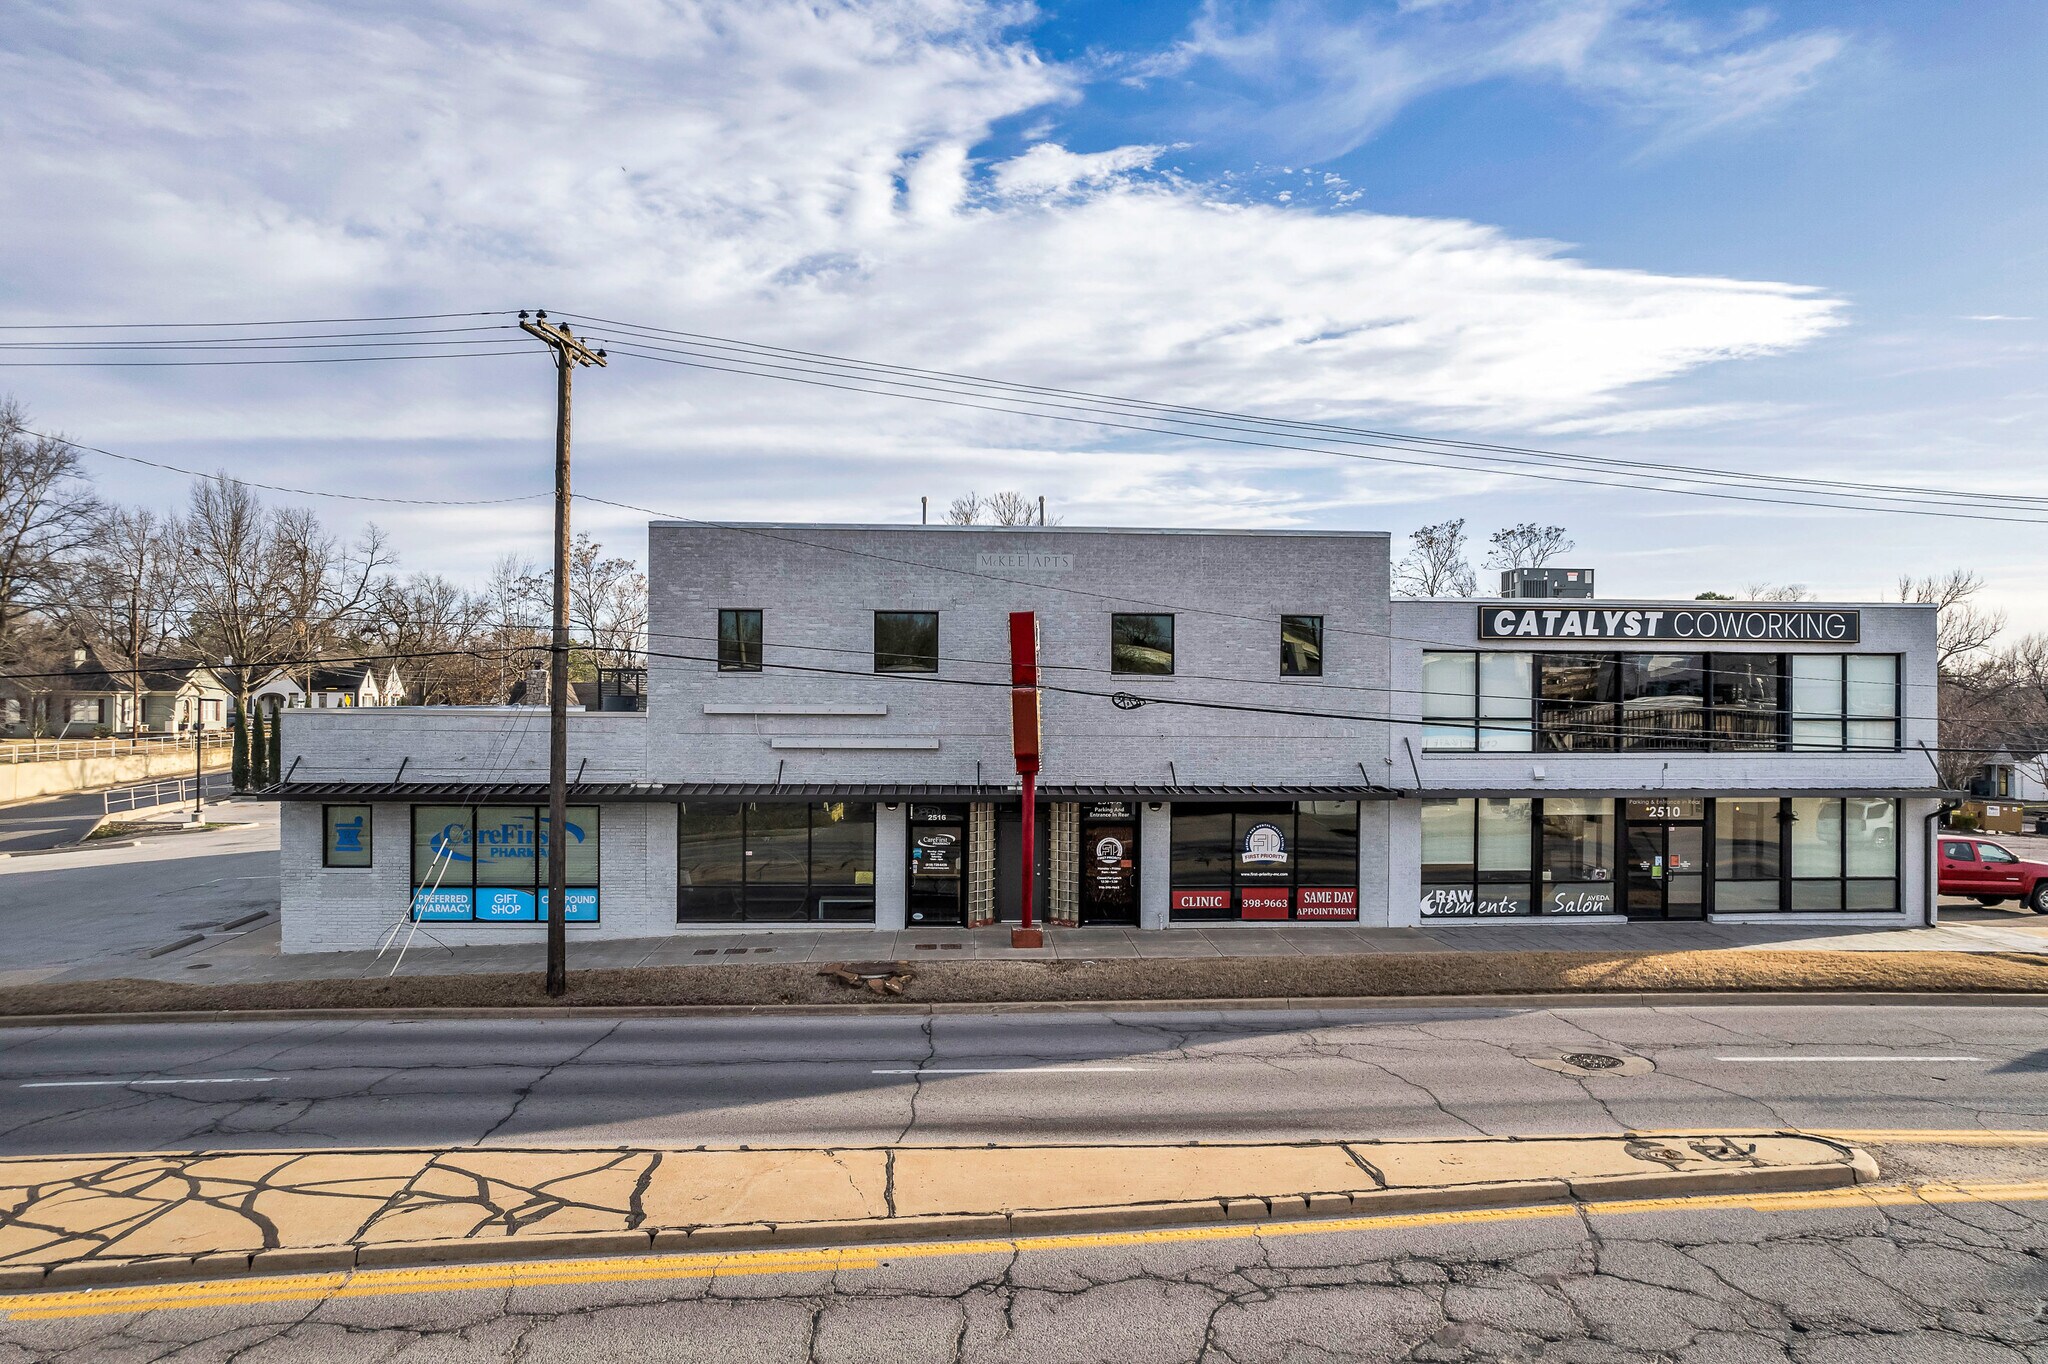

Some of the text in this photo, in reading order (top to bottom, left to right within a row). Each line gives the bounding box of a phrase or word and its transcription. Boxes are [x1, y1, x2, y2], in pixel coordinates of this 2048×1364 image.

[1033, 556, 1069, 567] APTS
[1493, 610, 1846, 639] CATALYST COWORKING
[1094, 806, 1113, 814] Parking
[1649, 806, 1681, 818] 2510
[443, 823, 549, 845] CareFirs
[490, 847, 549, 858] PHARMA
[418, 894, 469, 903] PREFERRED
[494, 894, 518, 904] GIFT
[541, 895, 597, 904] CPOUND
[1181, 896, 1222, 907] CLINIC
[1304, 891, 1354, 904] SAME DAY
[1435, 890, 1474, 903] RAW
[1551, 892, 1603, 912] Salon
[415, 904, 471, 913] PHARMACY
[564, 904, 578, 913] AB
[1242, 899, 1288, 908] 398-9663
[491, 904, 522, 915] SHOP
[1297, 907, 1357, 915] APPOINTMENT
